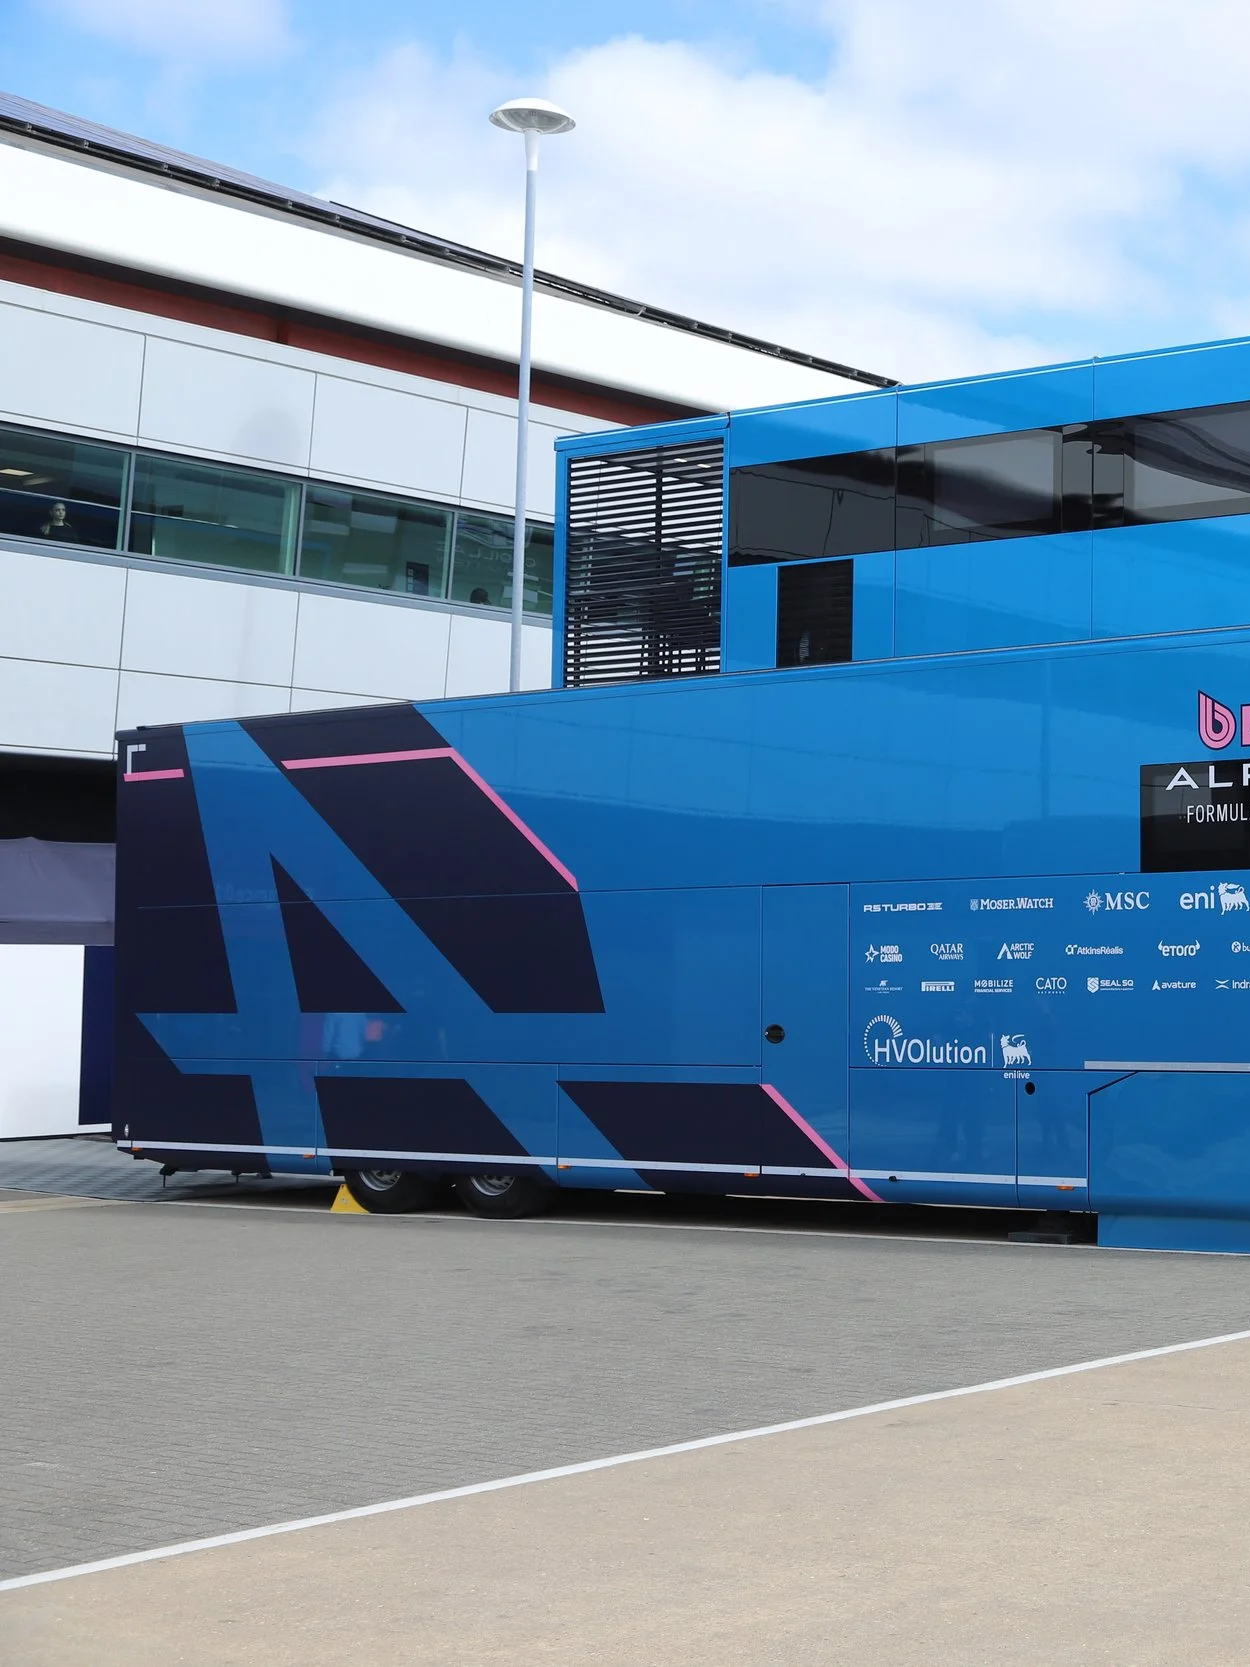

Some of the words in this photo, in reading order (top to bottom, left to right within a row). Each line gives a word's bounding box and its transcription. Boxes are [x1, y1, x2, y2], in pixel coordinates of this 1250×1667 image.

[1105, 891, 1150, 910] MSC
[1179, 885, 1215, 910] eni
[880, 945, 899, 954] MODO
[930, 943, 964, 956] QATAR
[1010, 943, 1035, 951] ARCTIC
[1077, 945, 1124, 955] AtkinsRéalis
[880, 953, 903, 963] CASINO
[1013, 951, 1032, 960] WOLF
[921, 981, 955, 992] PIRELLI
[1035, 977, 1067, 990] CATO
[1100, 979, 1121, 987] SEAL
[1122, 979, 1134, 987] SQ
[1161, 981, 1196, 989] avature
[874, 1039, 987, 1064] HVOlution
[1003, 1070, 1030, 1079] enilive
